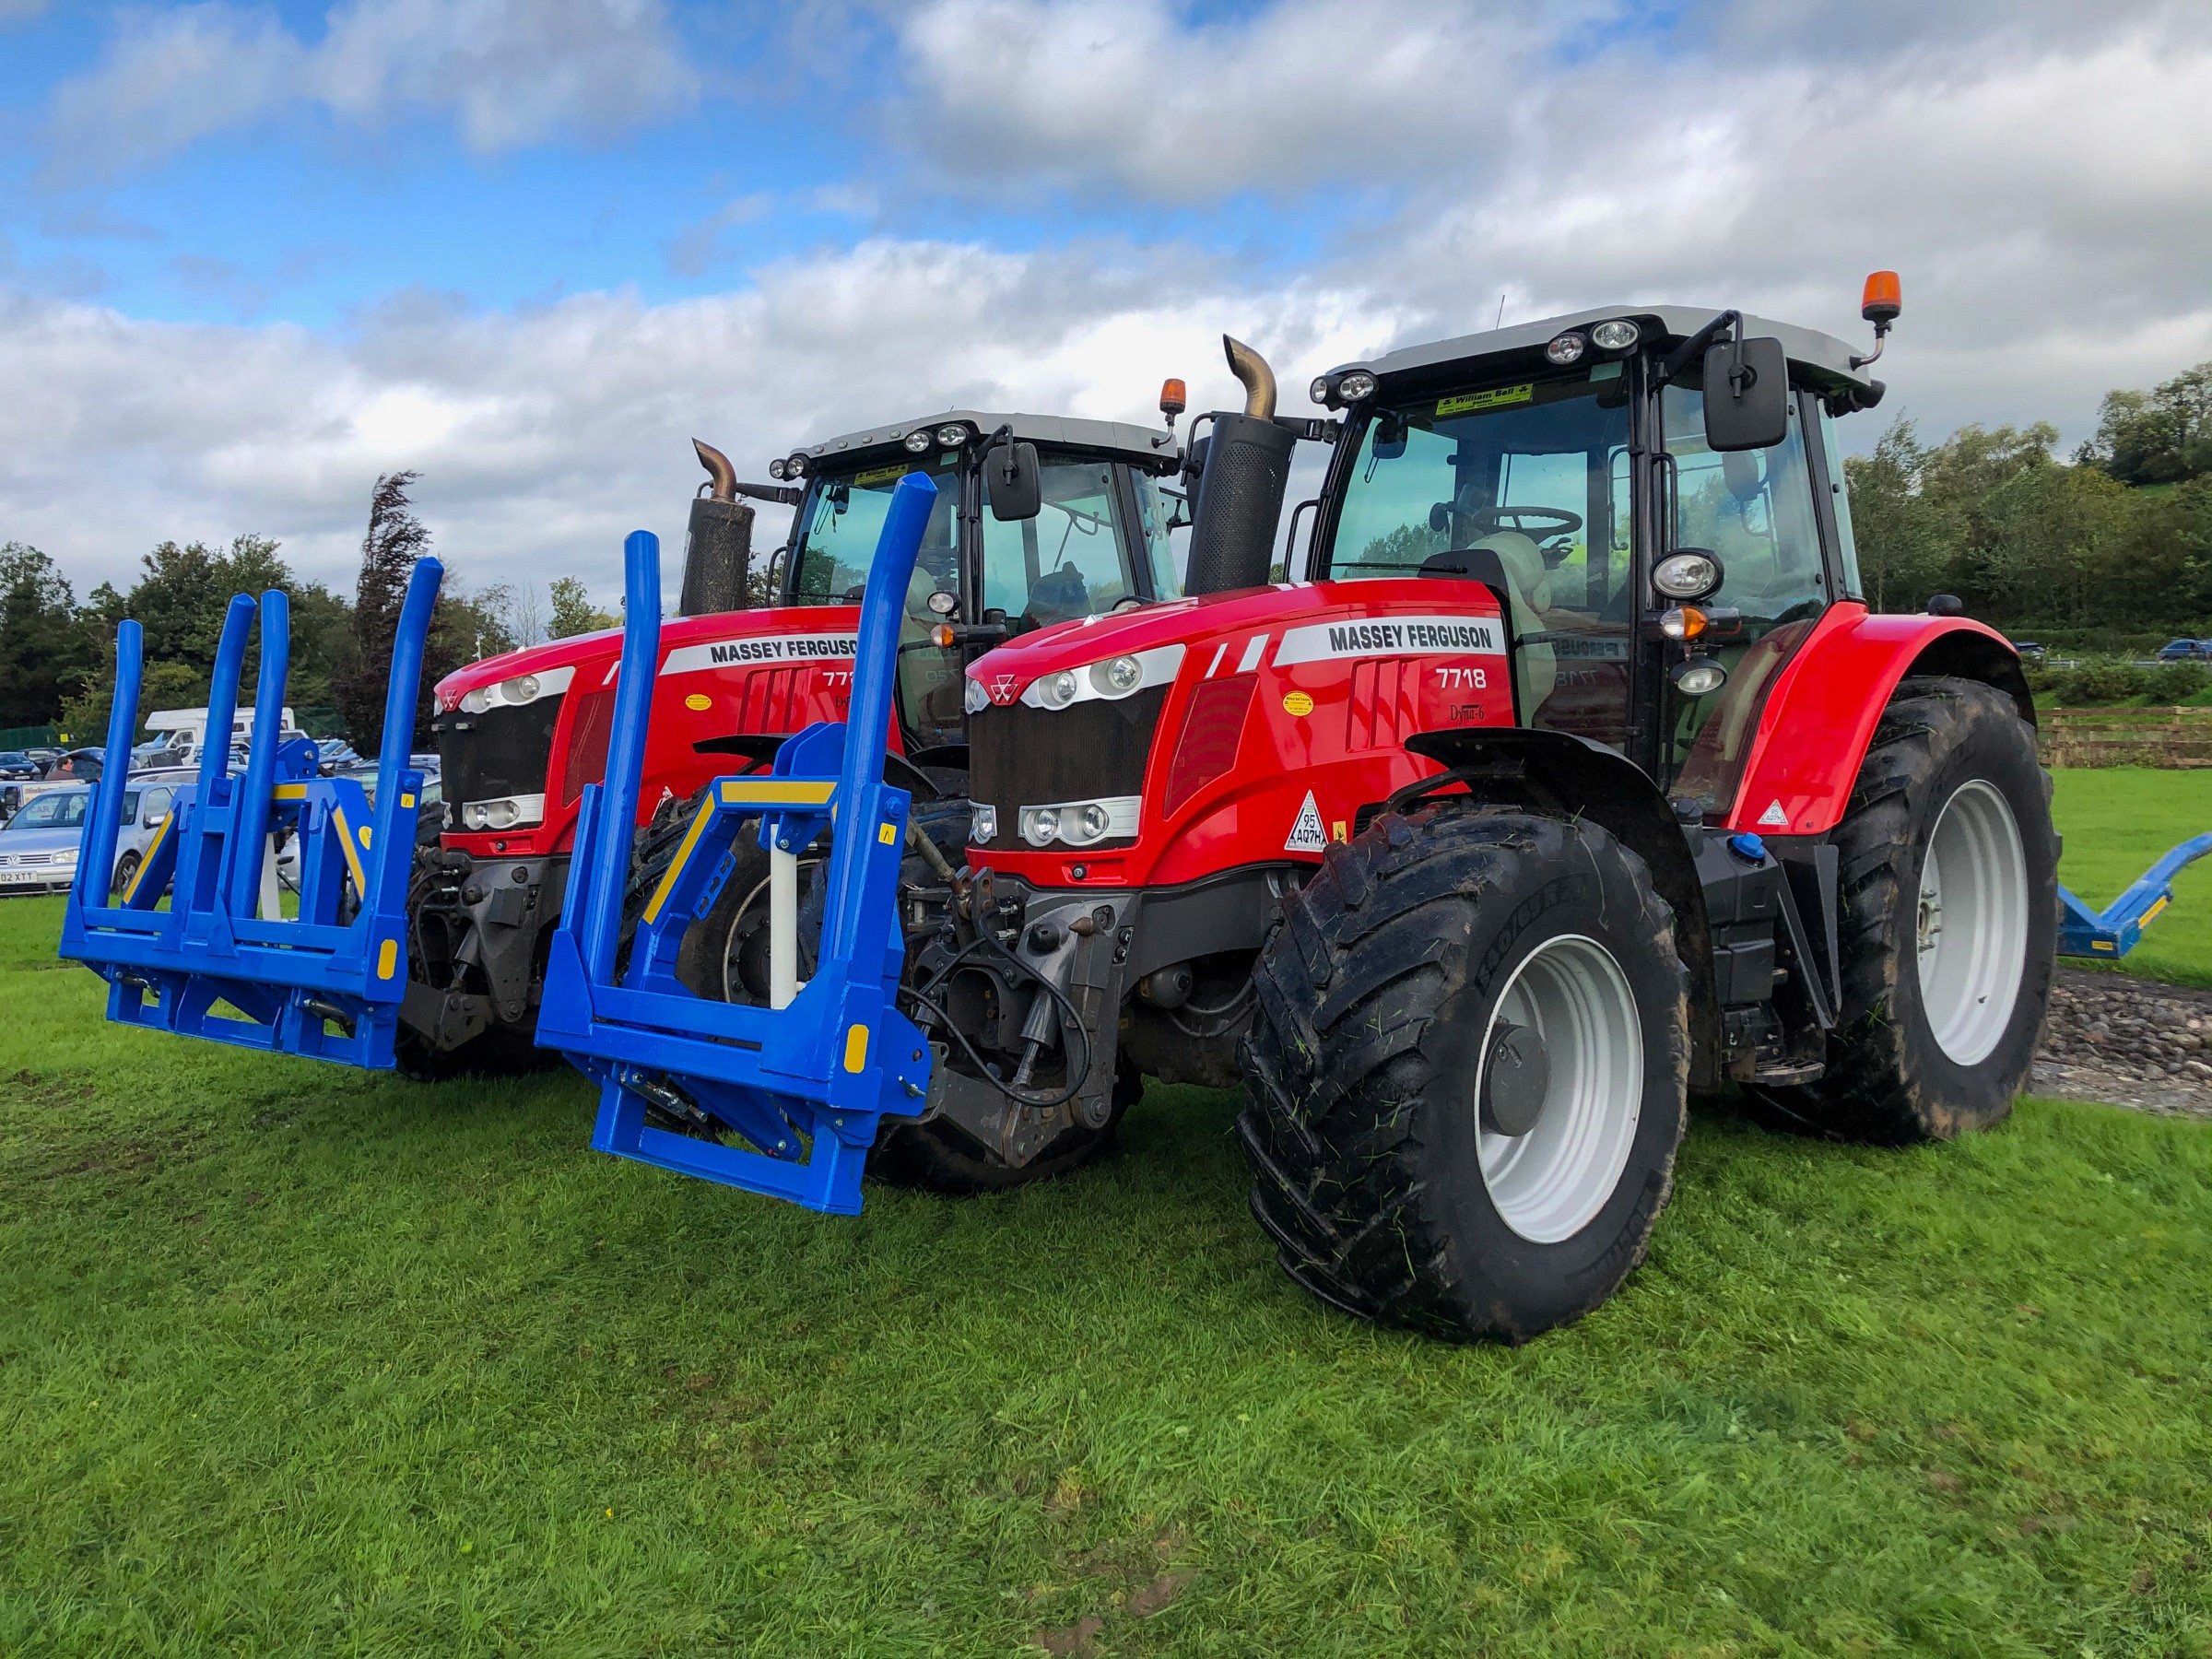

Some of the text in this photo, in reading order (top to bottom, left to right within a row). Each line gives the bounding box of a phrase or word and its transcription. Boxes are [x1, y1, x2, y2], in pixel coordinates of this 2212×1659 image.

[1455, 387, 1514, 404] William Bell
[1328, 625, 1492, 652] MASSEY FERGUSON
[710, 640, 856, 663] MASSEY FERGUSO
[822, 671, 853, 686] 77
[1435, 668, 1487, 688] 7718
[1450, 704, 1485, 725] Dyna-6
[1303, 814, 1315, 829] 95
[1297, 829, 1321, 844] AQ7H
[15, 872, 32, 881] XTT
